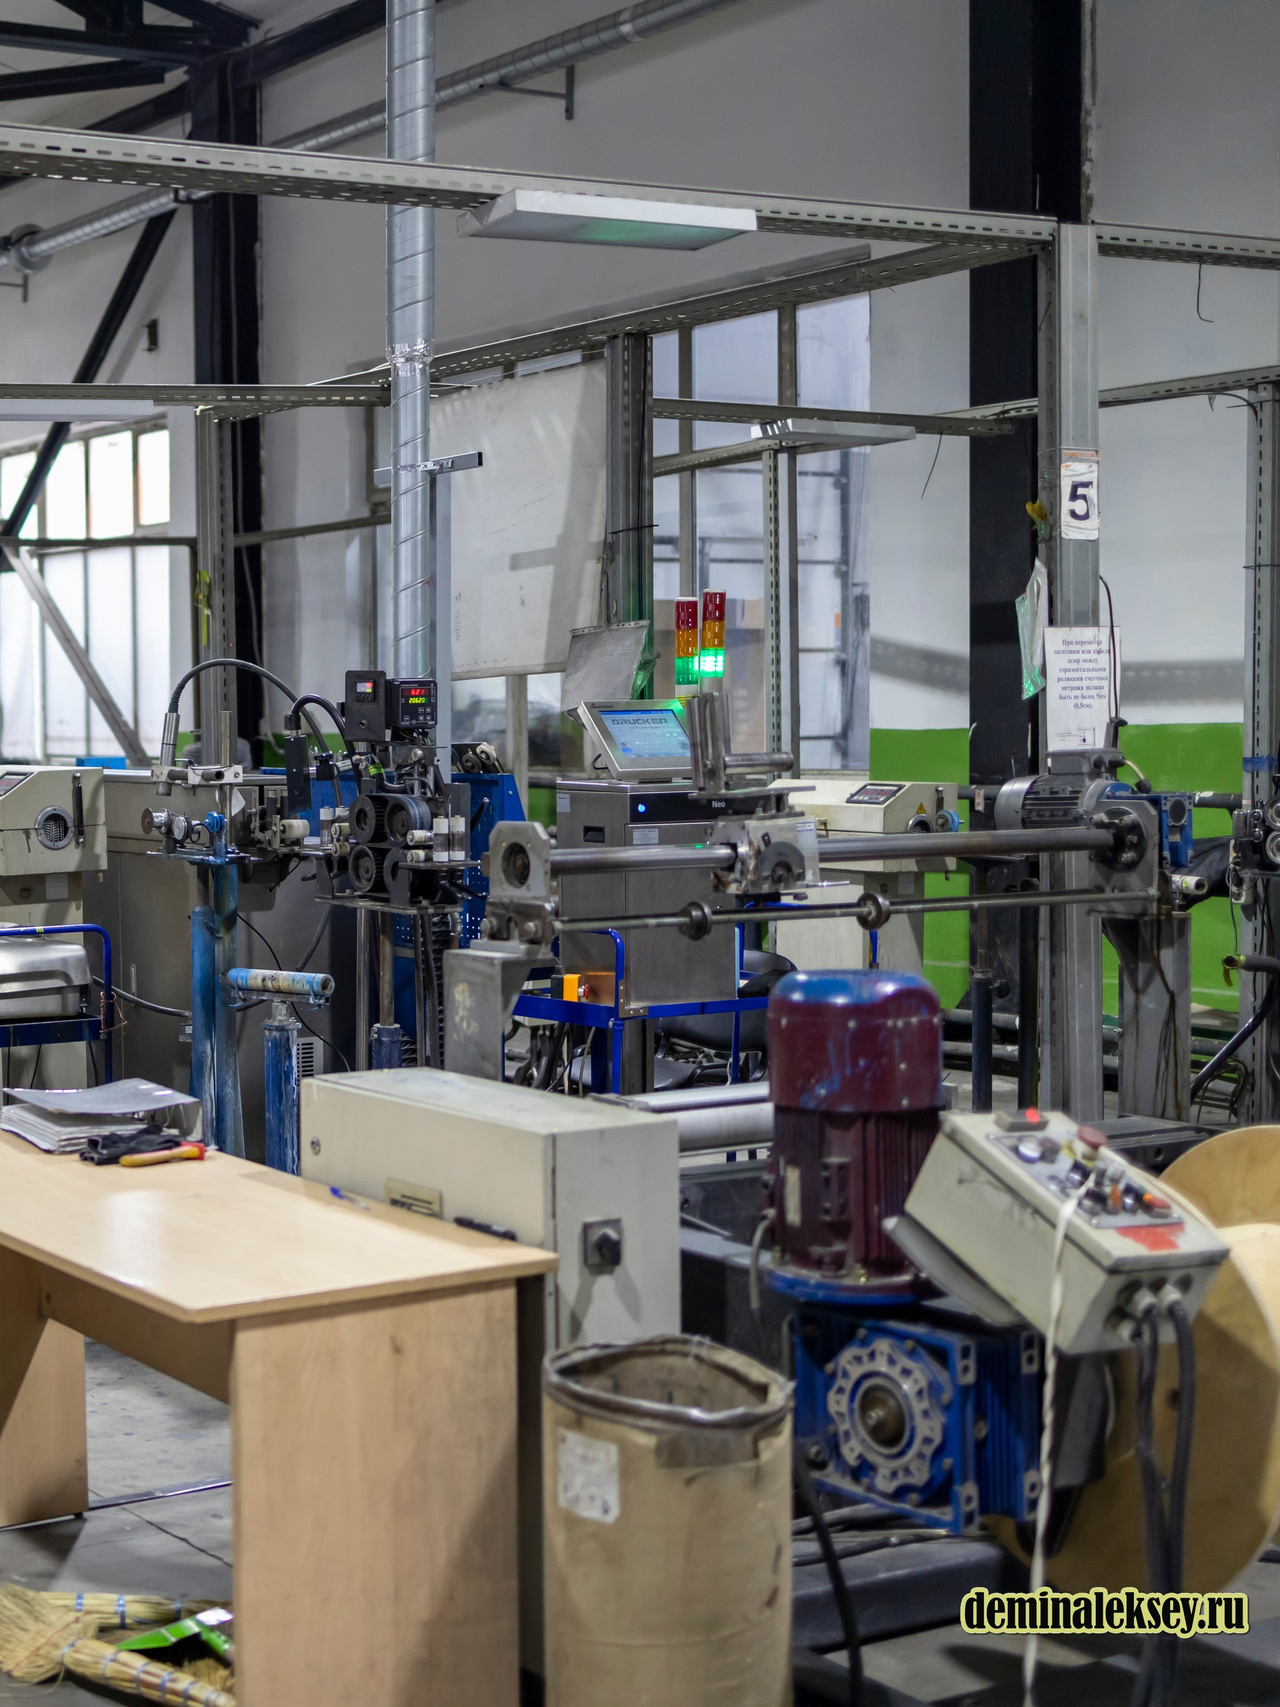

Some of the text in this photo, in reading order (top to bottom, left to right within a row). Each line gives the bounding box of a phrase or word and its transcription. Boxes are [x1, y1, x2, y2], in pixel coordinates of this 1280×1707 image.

[1068, 480, 1095, 521] 5
[1062, 639, 1073, 647] При
[711, 800, 726, 808] Neo
